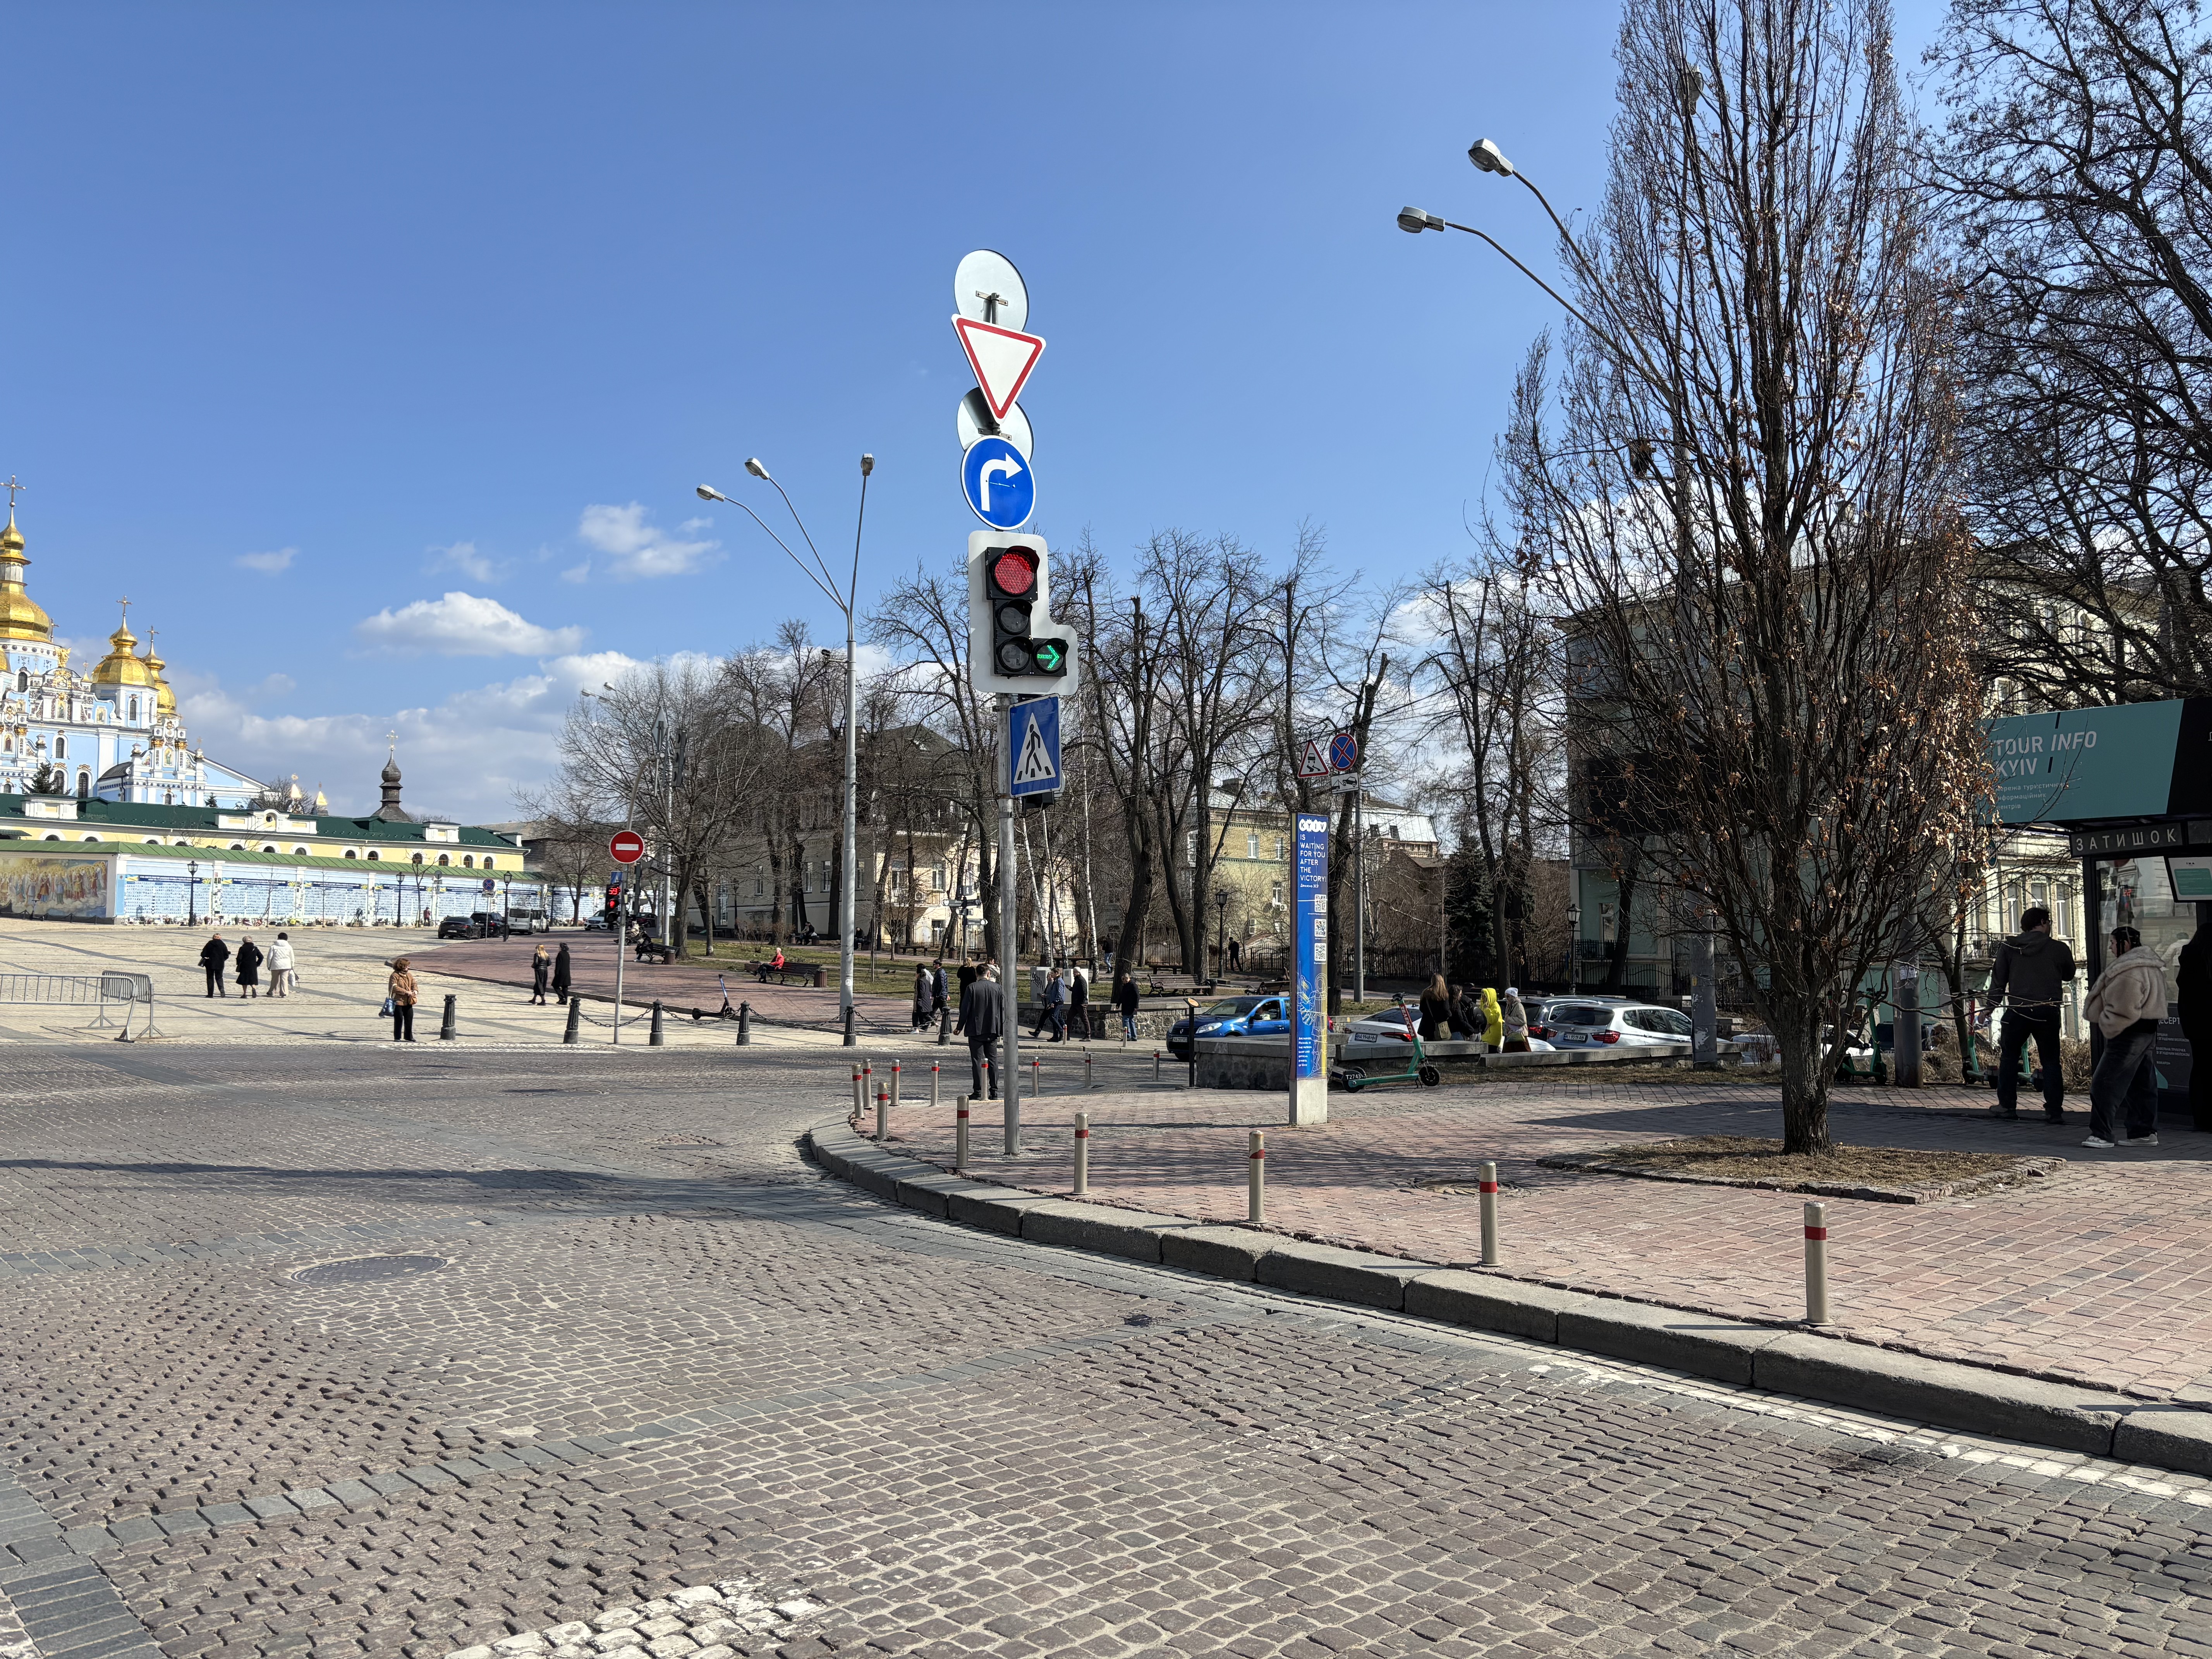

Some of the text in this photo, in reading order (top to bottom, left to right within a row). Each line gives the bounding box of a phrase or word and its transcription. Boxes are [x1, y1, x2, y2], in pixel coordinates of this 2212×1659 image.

[1994, 731, 2097, 756] TOUR INFO
[1996, 758, 2037, 777] KYIV
[1996, 793, 2046, 801] нформаційних
[1300, 842, 1324, 850] WAITING
[2076, 828, 2176, 851] ЗАТИШОК
